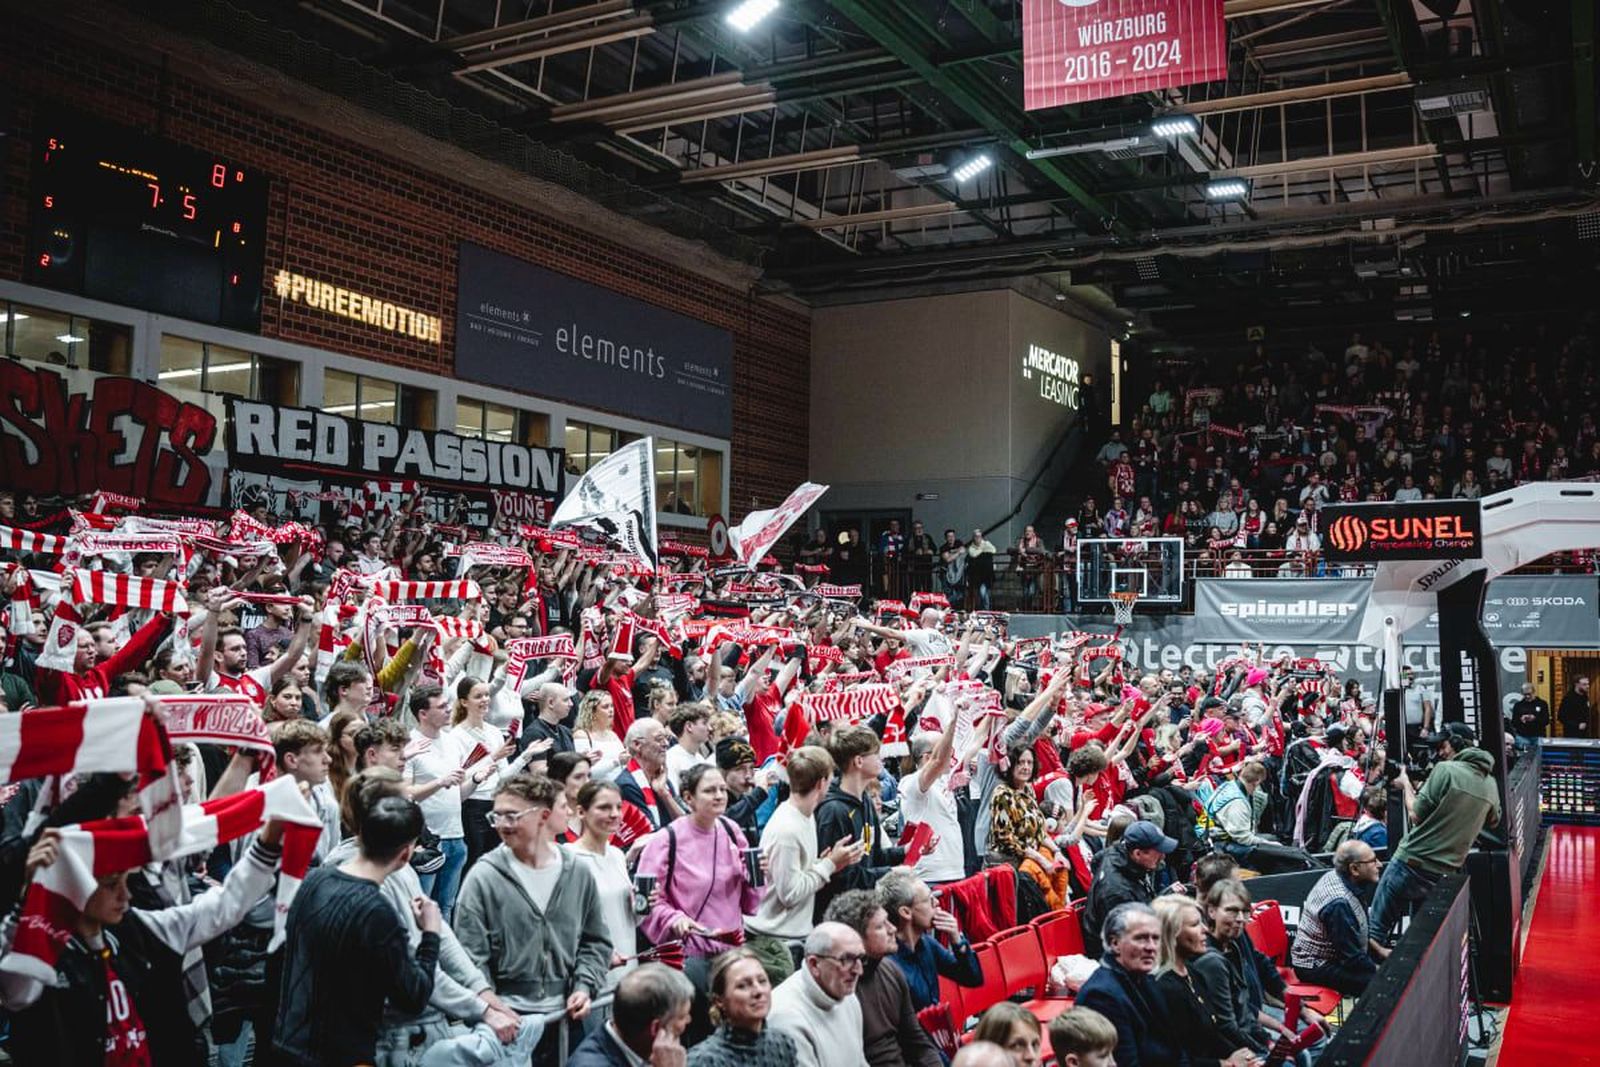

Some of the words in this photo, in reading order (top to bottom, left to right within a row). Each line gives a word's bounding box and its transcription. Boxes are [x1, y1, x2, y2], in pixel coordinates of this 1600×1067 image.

[1078, 12, 1167, 48] WÜRZBURG
[1064, 51, 1111, 83] 2016
[1132, 39, 1182, 72] 2024
[212, 164, 226, 188] 8
[273, 269, 442, 344] #PUREEMOTION
[556, 323, 665, 378] elements
[1028, 344, 1079, 385] MERCATOR
[1041, 374, 1080, 410] LEASING
[233, 401, 348, 467] RED
[362, 422, 563, 492] PASSION
[1370, 516, 1473, 540] SUNEL
[1220, 600, 1358, 618] spindler
